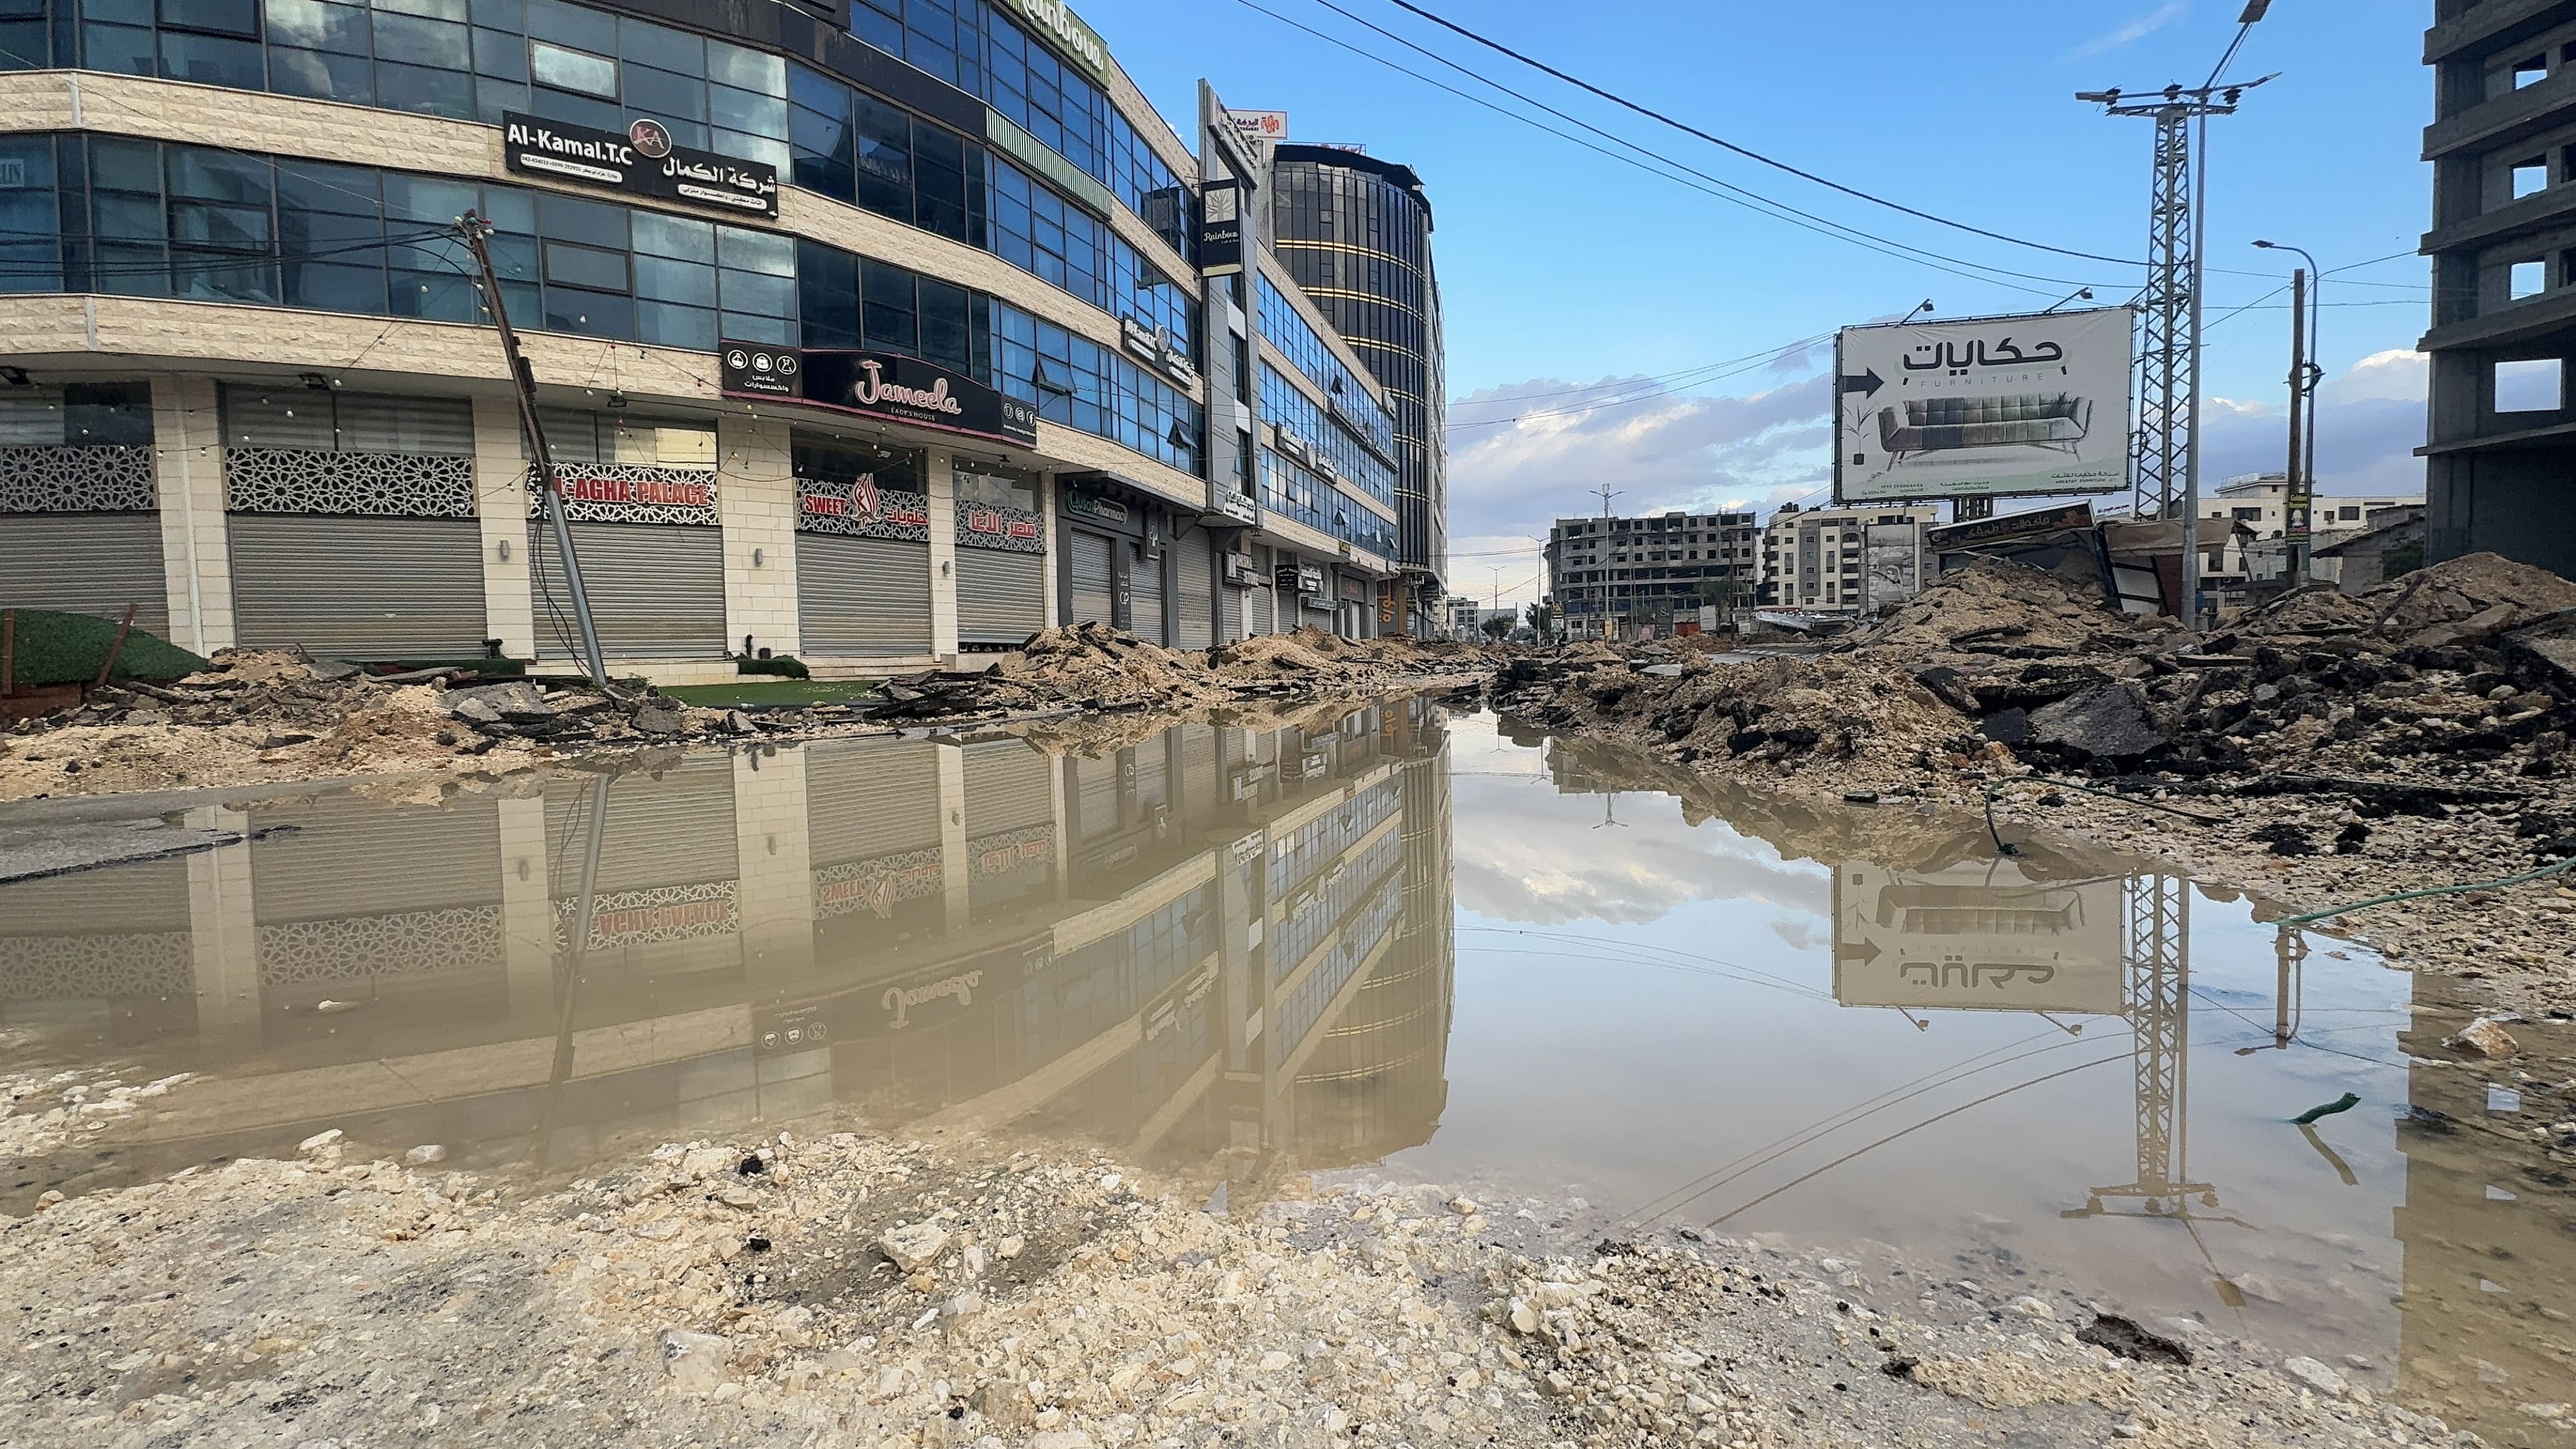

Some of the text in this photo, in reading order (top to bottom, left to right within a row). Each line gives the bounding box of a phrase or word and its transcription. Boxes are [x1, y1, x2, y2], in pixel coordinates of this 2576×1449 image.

[662, 156, 776, 195] شركة الكمال
[1203, 229, 1239, 242] Rainbow
[1902, 337, 2063, 377] حكايات
[855, 360, 963, 415] Jameela
[1920, 372, 2044, 388] FURNITURE
[913, 411, 936, 422] HOUSE
[553, 476, 709, 506] L-AGHA PALACE
[804, 494, 847, 515] SWEET
[1093, 499, 1128, 523] Pharmacy
[885, 506, 929, 527] حلويات
[1006, 517, 1036, 539] قصر
